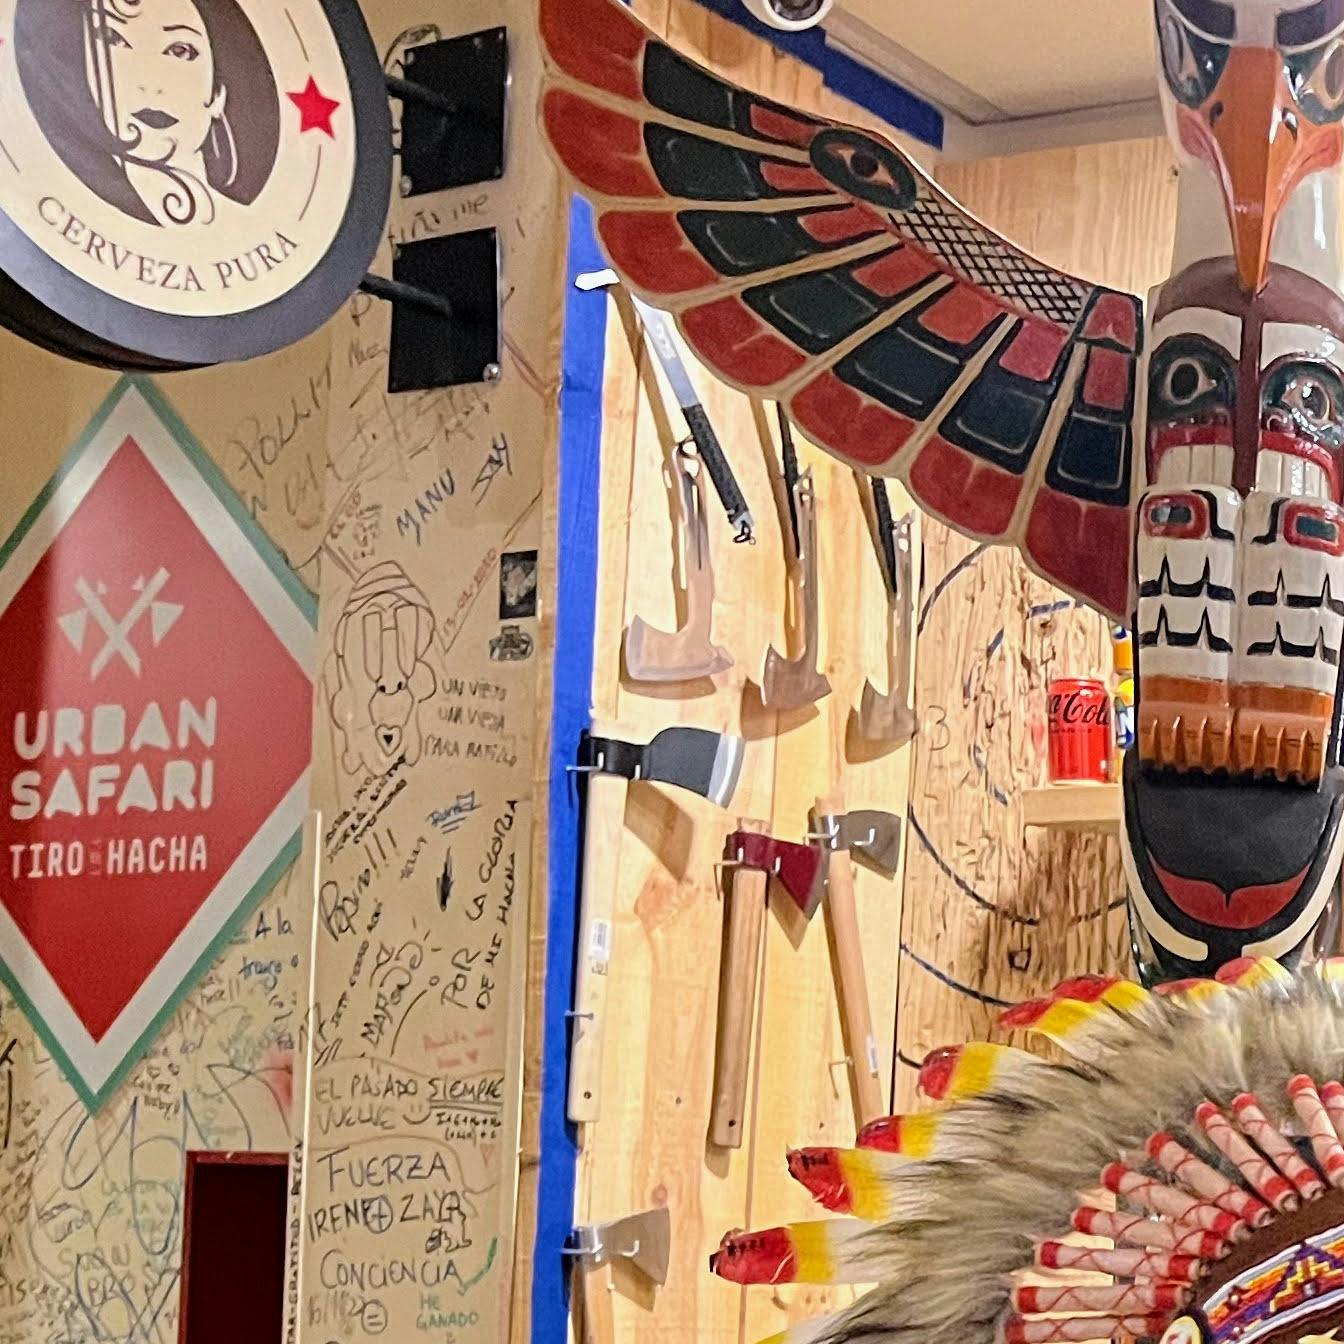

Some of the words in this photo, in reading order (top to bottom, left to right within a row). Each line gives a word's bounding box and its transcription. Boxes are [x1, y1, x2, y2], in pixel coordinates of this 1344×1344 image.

[38, 196, 206, 292] CERVEZA
[212, 231, 298, 289] PURA
[396, 468, 457, 547] MANU
[14, 695, 218, 761] URBAN
[9, 758, 215, 821] SAFARI
[9, 839, 85, 880] TIRO
[105, 833, 208, 875] HACHA
[314, 1079, 342, 1102] EL
[351, 1073, 419, 1099] PASADO
[316, 1145, 452, 1192] FUERZA
[320, 1248, 464, 1292] CONCIENCIA
